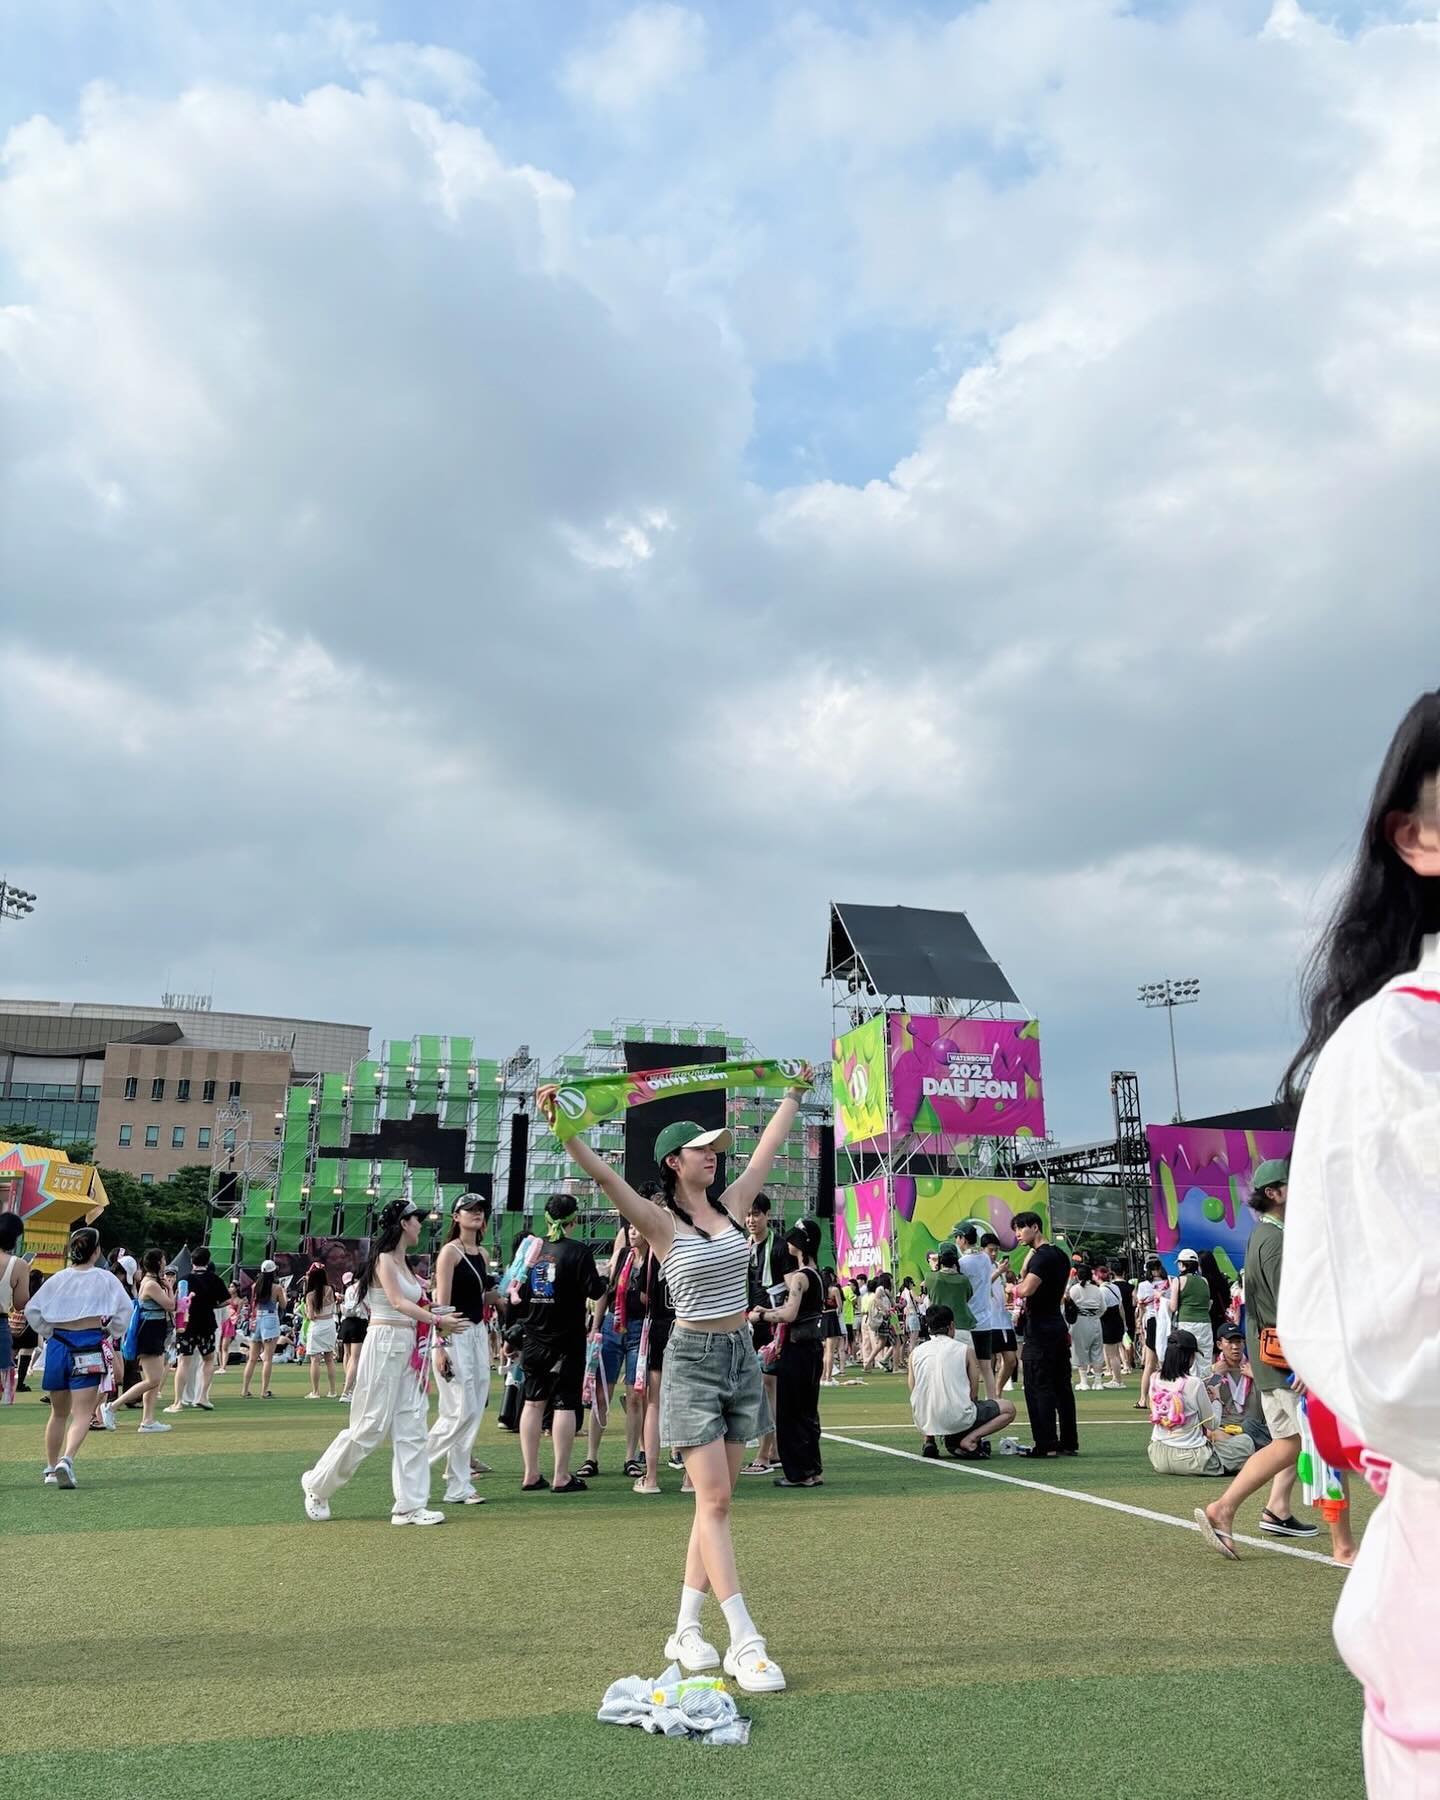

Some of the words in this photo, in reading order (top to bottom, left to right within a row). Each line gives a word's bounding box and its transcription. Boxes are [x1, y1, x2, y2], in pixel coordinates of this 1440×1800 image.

[949, 1064, 993, 1079] 2024
[647, 1075, 689, 1090] OLIVE
[922, 1077, 1018, 1099] DAEJEON
[52, 1177, 83, 1191] 2024
